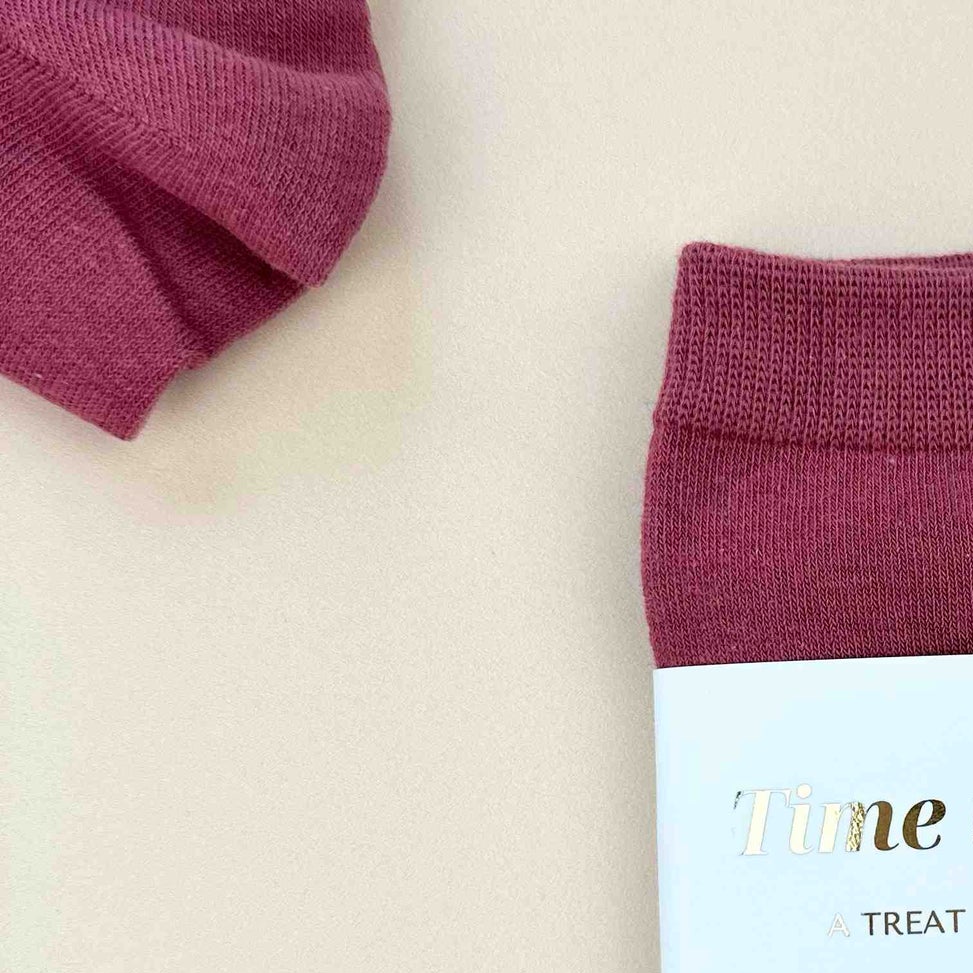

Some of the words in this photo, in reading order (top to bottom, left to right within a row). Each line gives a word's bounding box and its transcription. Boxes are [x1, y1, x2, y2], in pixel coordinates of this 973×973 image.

[732, 782, 948, 857] Time
[827, 911, 850, 938] A
[861, 908, 967, 937] TREAT
